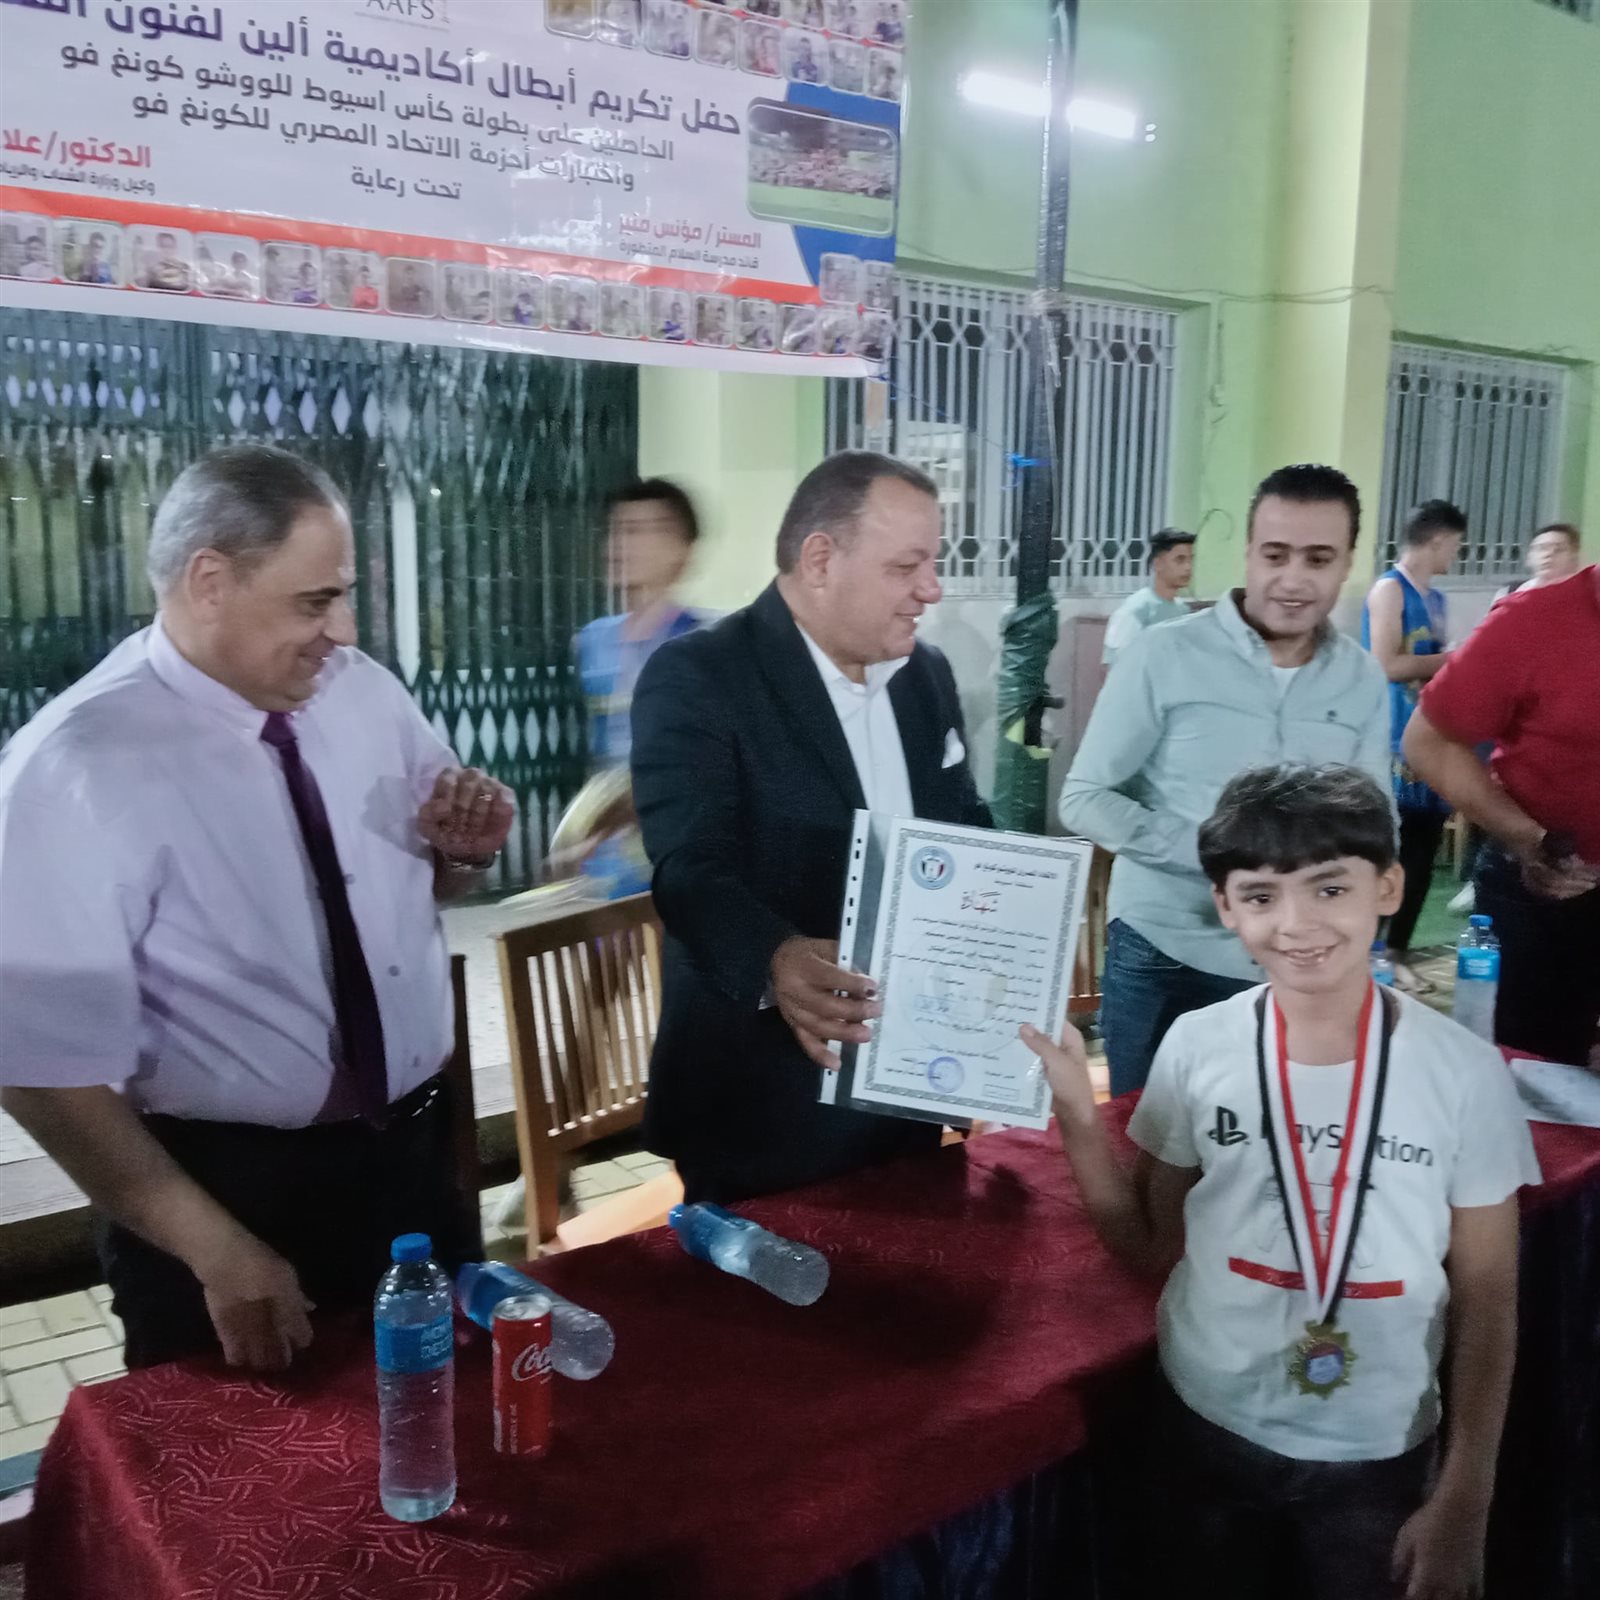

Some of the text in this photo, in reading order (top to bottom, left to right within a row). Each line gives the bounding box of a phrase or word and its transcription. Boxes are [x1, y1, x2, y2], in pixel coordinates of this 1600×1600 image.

[105, 0, 223, 41] لفنون
[239, 16, 309, 62] ألين
[324, 30, 474, 87] أكاديمية
[61, 42, 674, 161] الحاصلين على بطولة كأس اسيوط للووشو كونغ فو
[487, 62, 576, 111] أبطال
[589, 88, 673, 123] تكريم
[681, 98, 741, 135] حفل
[132, 92, 635, 192] واختبارات أحزمة الاتحاد المصري للكونغ فو
[122, 177, 156, 196] وكيل
[351, 165, 462, 200] تحت رعاية
[619, 212, 650, 236] منير
[654, 220, 702, 244] مؤنس
[716, 226, 762, 249] المستر
